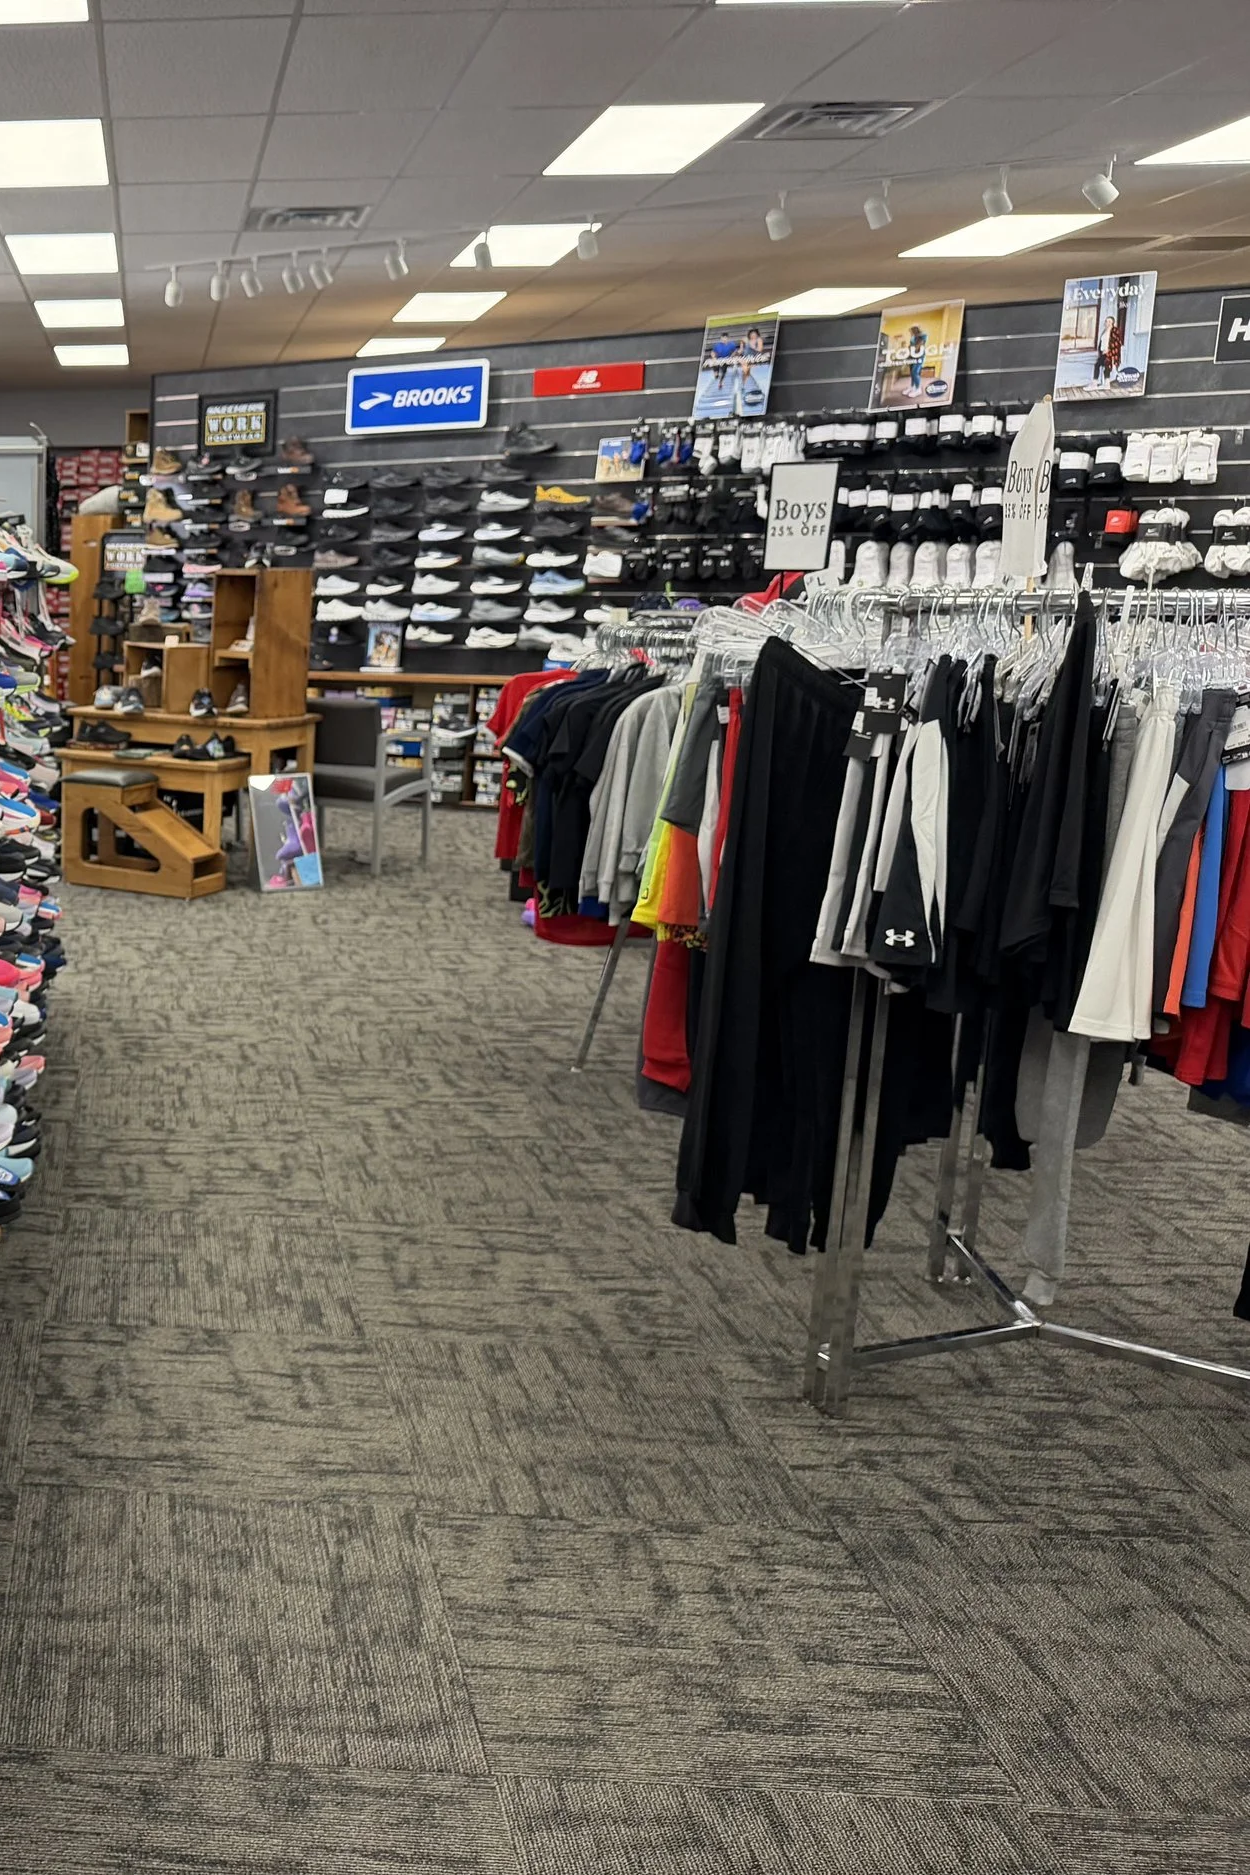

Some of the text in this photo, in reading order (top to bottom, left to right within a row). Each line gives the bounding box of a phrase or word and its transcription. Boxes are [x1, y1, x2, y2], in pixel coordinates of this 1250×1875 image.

[1073, 281, 1149, 302] Everyday
[1227, 317, 1250, 343] H
[881, 341, 956, 362] TOUGH
[393, 385, 474, 408] BROOKS
[208, 414, 261, 433] WORK
[1007, 460, 1034, 502] Boys
[774, 499, 827, 529] Boys
[770, 524, 826, 537] 25% OFF
